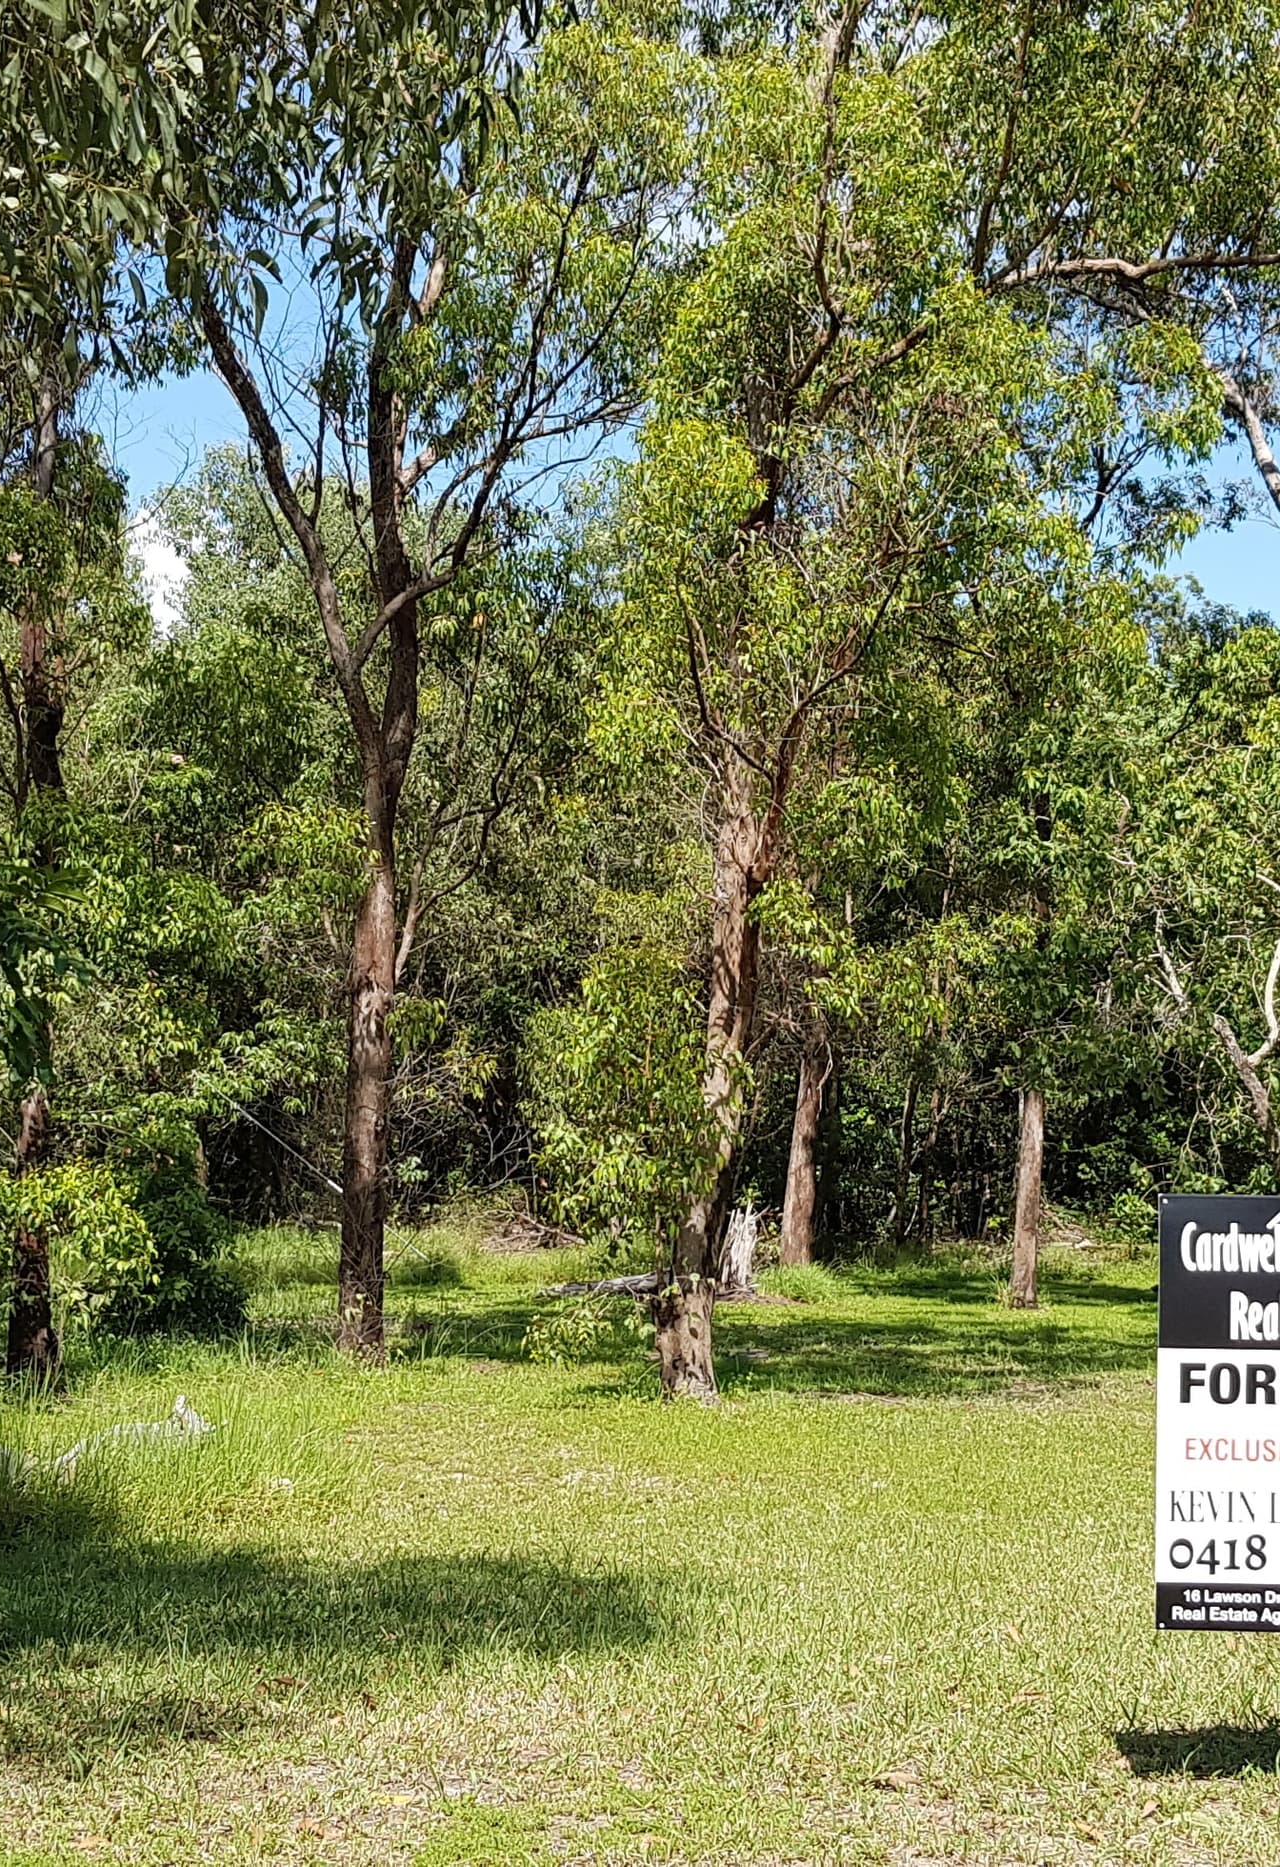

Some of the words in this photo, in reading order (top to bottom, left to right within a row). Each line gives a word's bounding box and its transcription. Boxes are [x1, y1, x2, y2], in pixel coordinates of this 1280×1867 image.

[1179, 1362, 1277, 1405] FOR
[1169, 1490, 1256, 1523] KEVIN
[1169, 1534, 1268, 1575] 0418
[1183, 1589, 1201, 1603] 16
[1204, 1589, 1262, 1604] Lawson
[1171, 1605, 1206, 1621] Real
[1209, 1606, 1258, 1623] Estate
